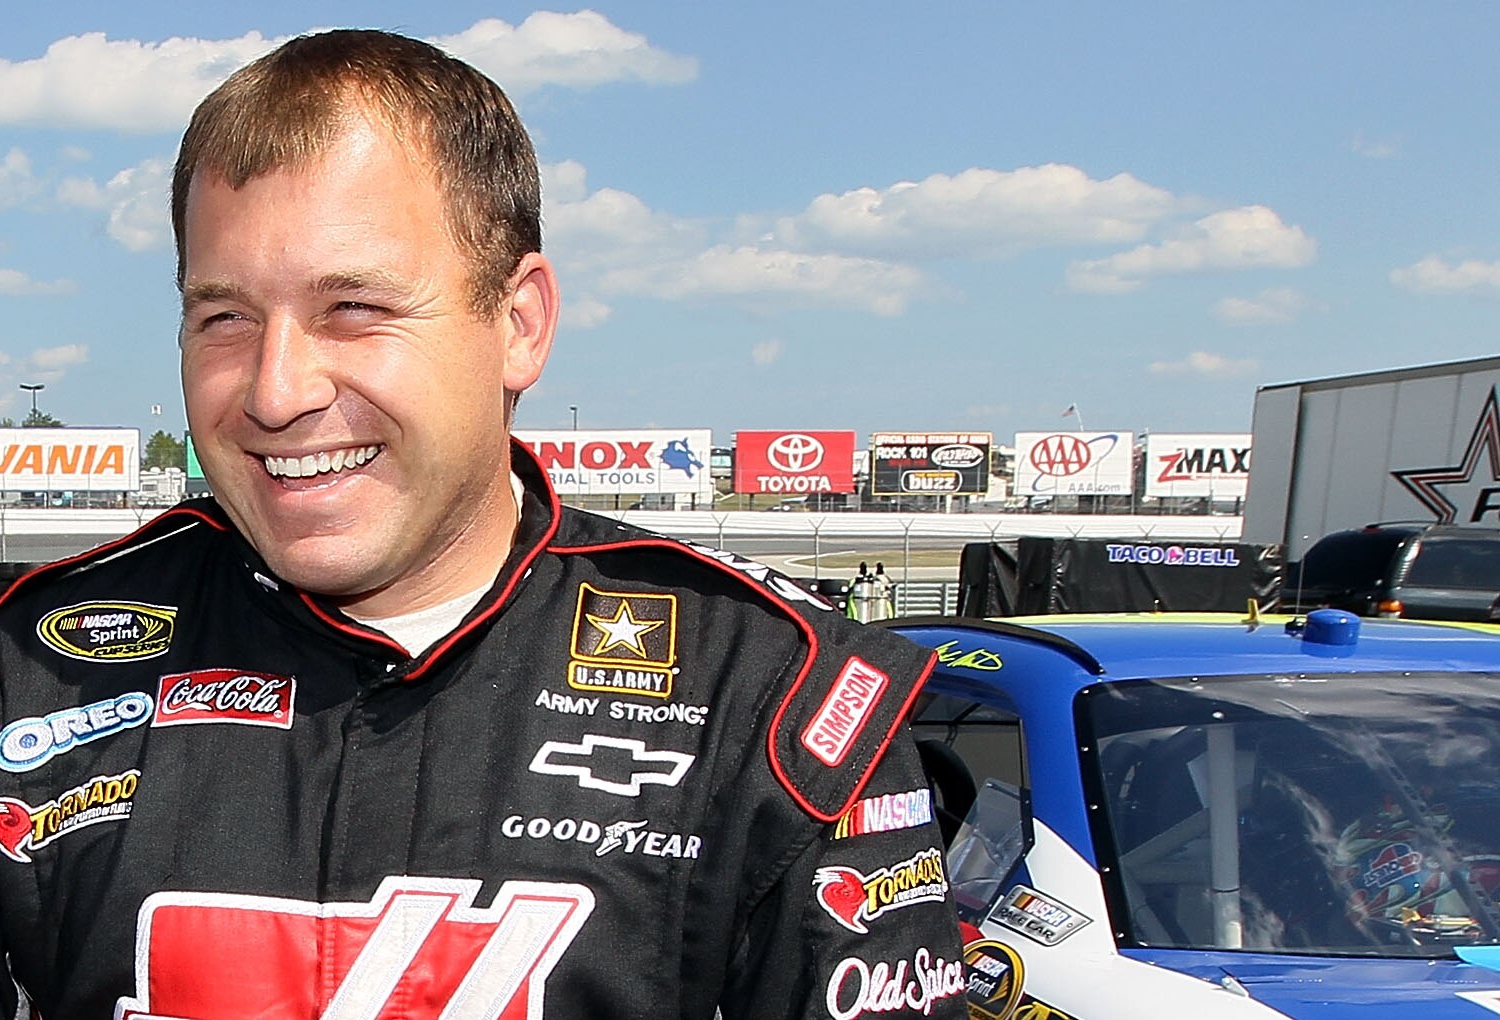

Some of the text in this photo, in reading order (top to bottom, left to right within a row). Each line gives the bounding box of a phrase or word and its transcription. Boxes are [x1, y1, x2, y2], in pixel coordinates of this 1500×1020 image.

[1034, 443, 1089, 470] AAA
[597, 472, 656, 485] TOOLS
[758, 476, 831, 492] TOYOTA
[909, 474, 956, 490] buzz
[1067, 482, 1122, 494] AAA.com
[1107, 544, 1240, 567] TACO BELL
[82, 613, 133, 629] NASCAR
[90, 625, 140, 645] Sprint
[535, 689, 599, 716] ARMY
[813, 666, 878, 757] SIMPSON
[0, 696, 151, 765] OREO
[999, 906, 1056, 940] RACE CAR
[1024, 898, 1069, 928] NASCAR
[973, 954, 1009, 978] NASCAR
[965, 972, 997, 997] Sprint
